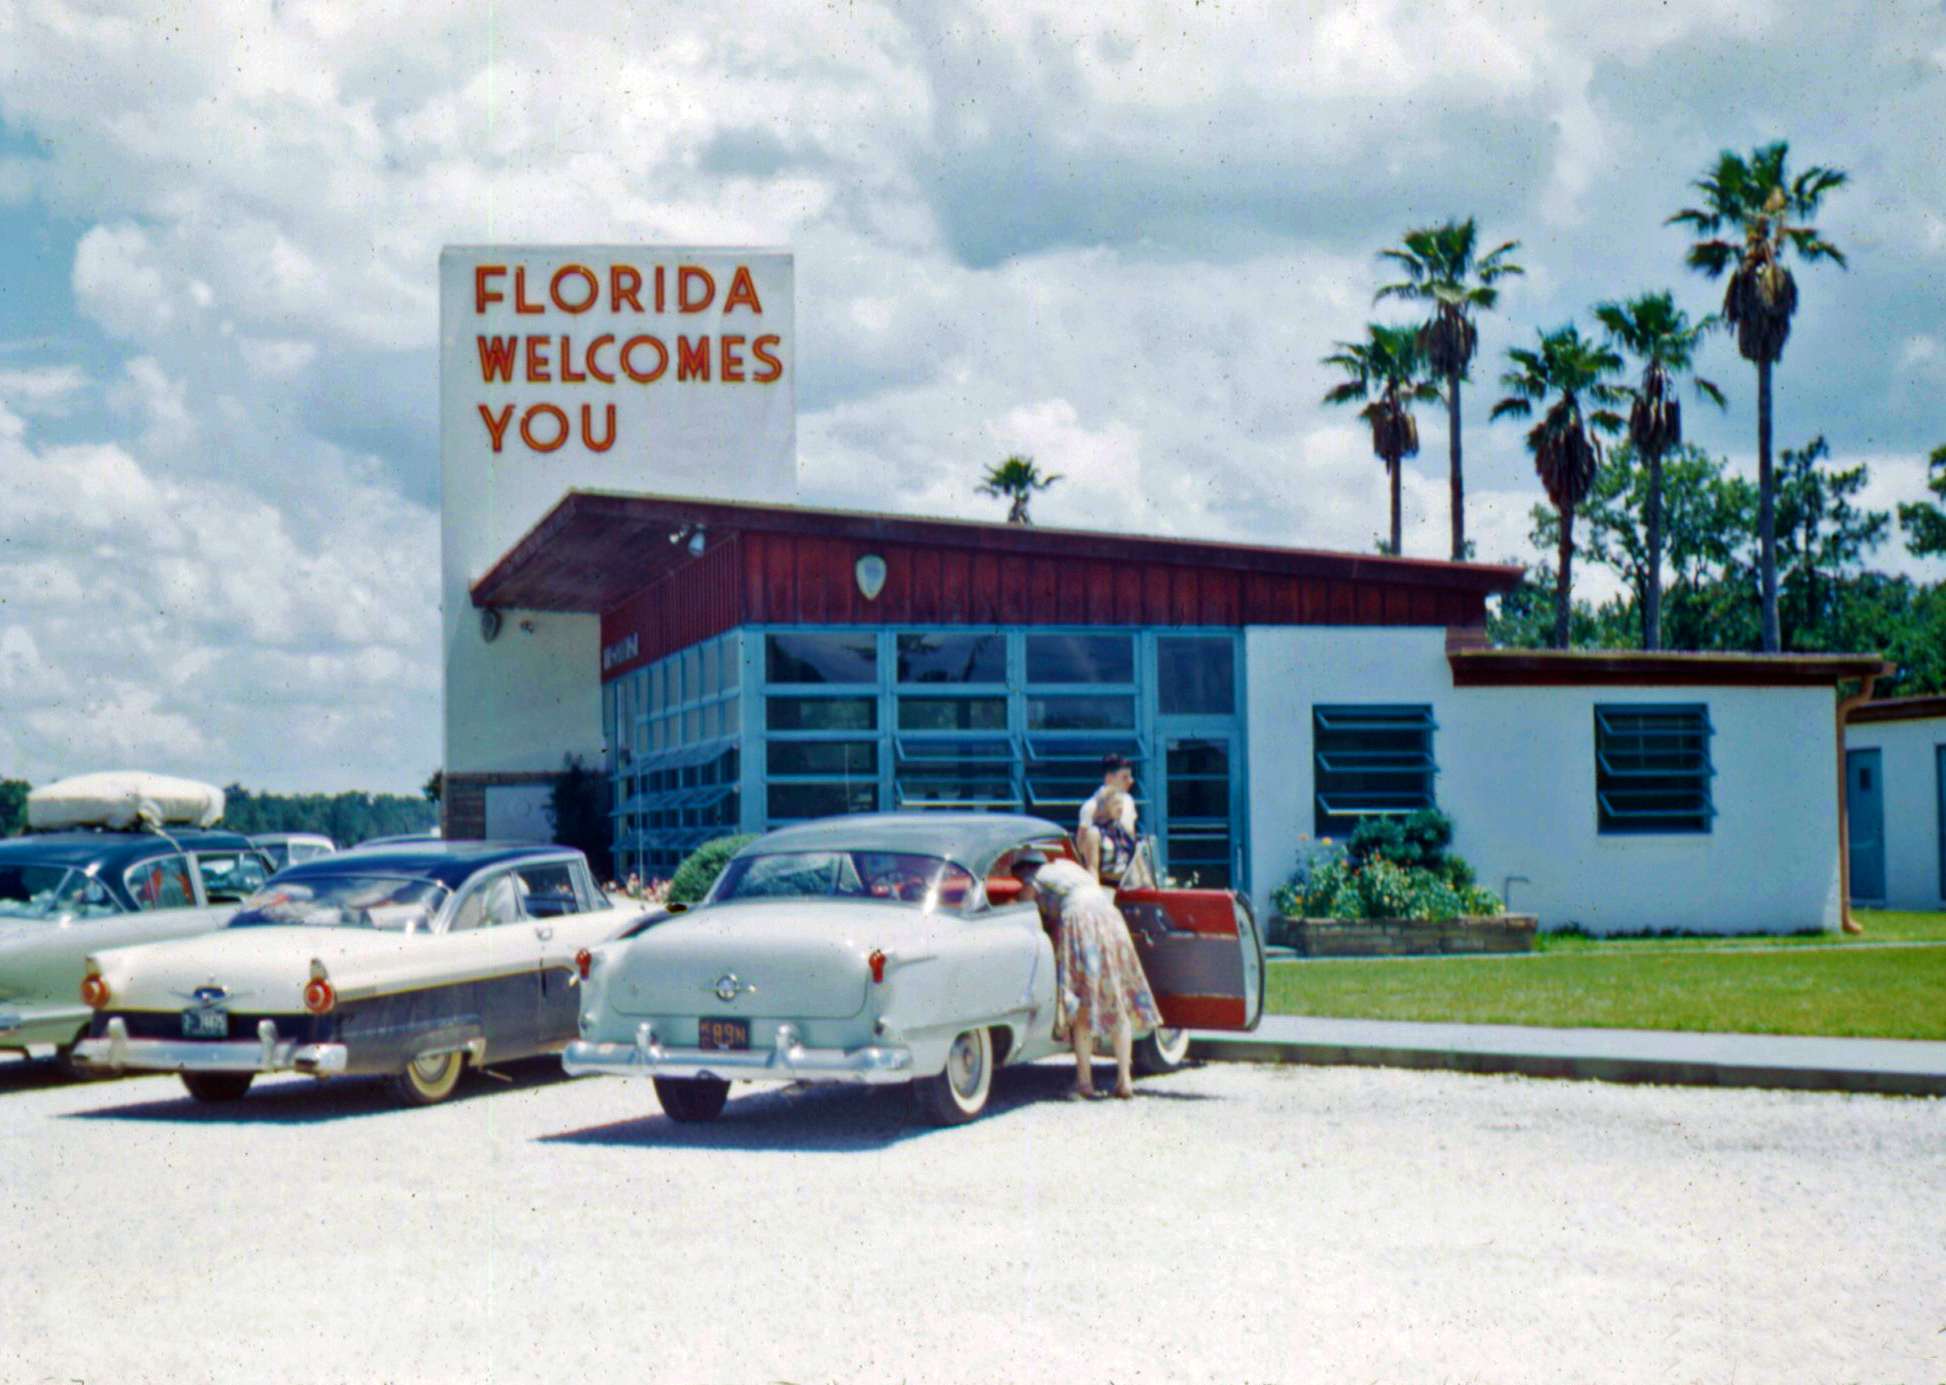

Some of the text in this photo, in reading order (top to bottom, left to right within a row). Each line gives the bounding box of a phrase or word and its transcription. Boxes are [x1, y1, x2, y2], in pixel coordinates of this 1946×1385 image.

[475, 264, 763, 315] FLORIDA
[476, 334, 783, 384] WELCOMES
[477, 402, 616, 454] YOU
